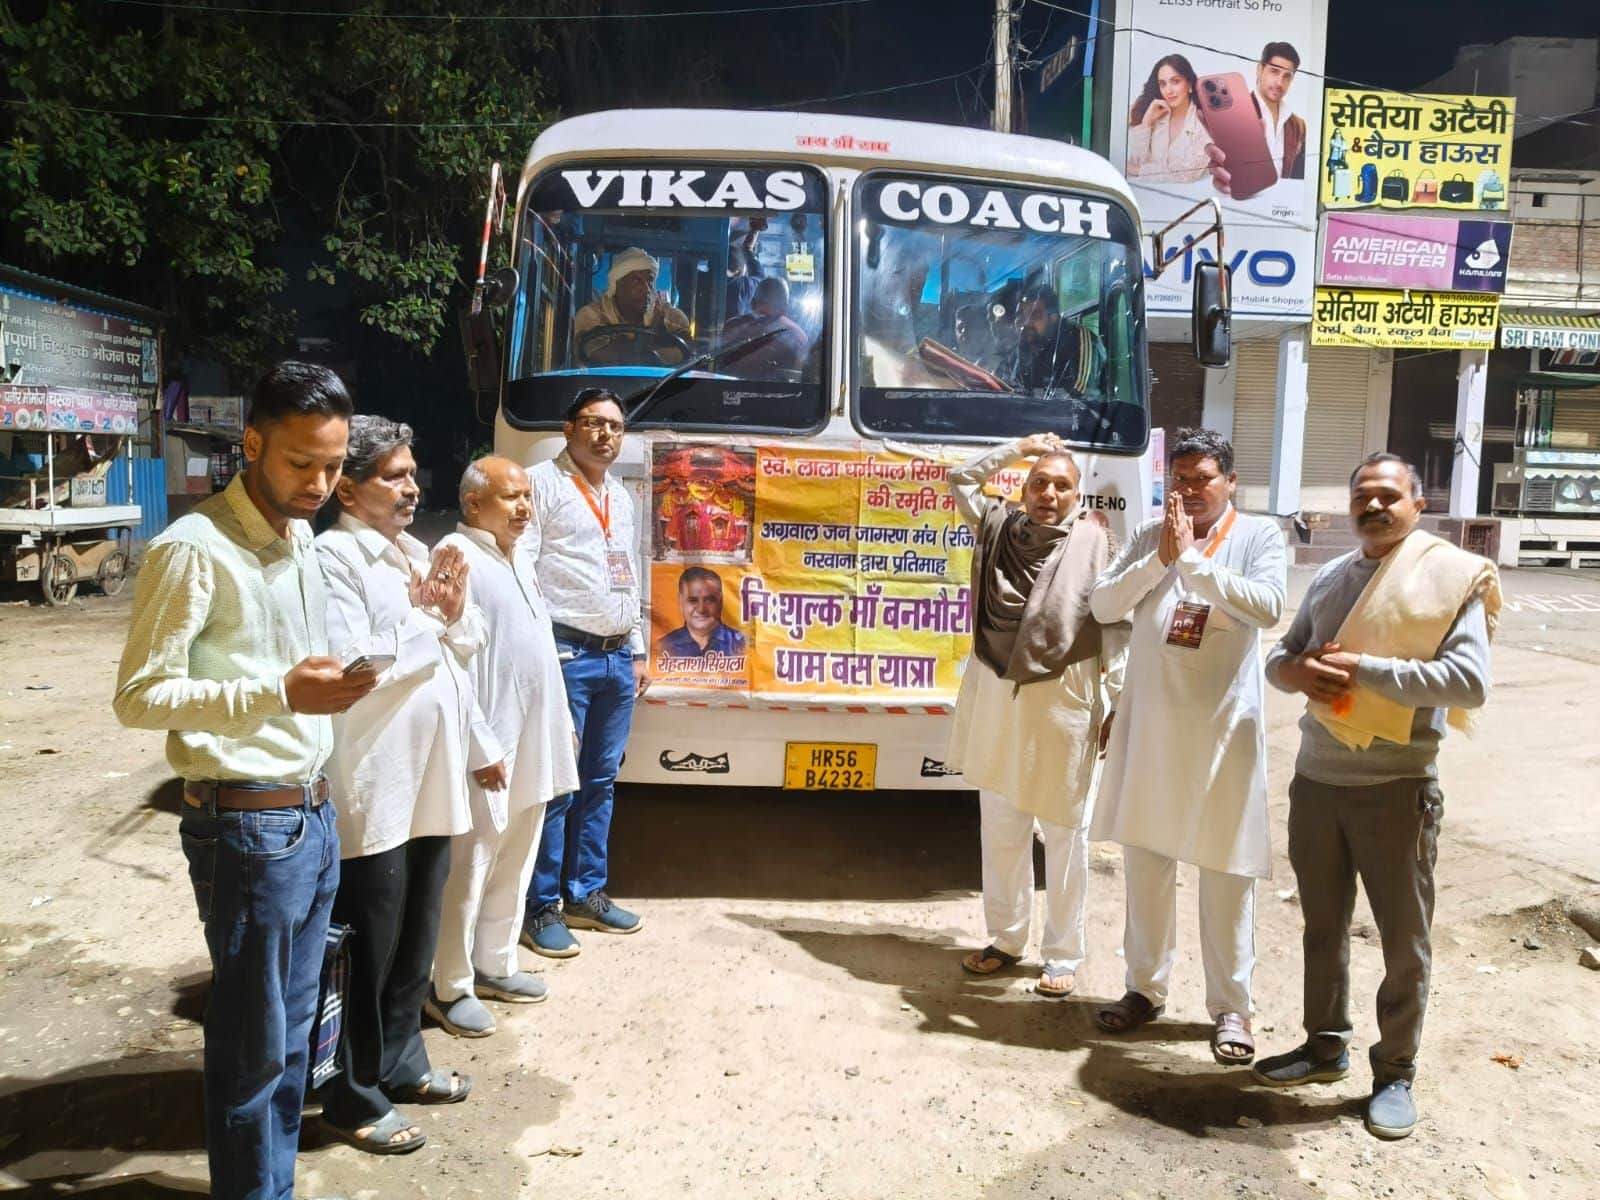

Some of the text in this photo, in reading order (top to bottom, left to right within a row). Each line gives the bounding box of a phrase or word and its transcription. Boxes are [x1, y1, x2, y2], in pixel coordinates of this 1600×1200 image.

[1244, 0, 1259, 10] So
[1262, 0, 1282, 12] Pro
[1330, 94, 1423, 131] सेतिया
[1419, 141, 1501, 165] हाऊस
[562, 169, 1111, 239] VIKAS COACH
[1332, 236, 1448, 255] AMERICAN
[1331, 250, 1447, 268] TOURISTER
[1316, 290, 1379, 323] सेतिया
[1440, 303, 1497, 327] हाऊस
[1505, 329, 1600, 348] SRI RAM CON
[797, 459, 841, 478] लाला
[910, 457, 951, 482] सिंग
[867, 485, 890, 508] की
[895, 487, 937, 516] स्मृति
[761, 522, 820, 543] अग्रवाल
[823, 524, 850, 542] जन
[855, 525, 908, 545] जागरण
[912, 523, 938, 546] मंच
[804, 550, 947, 576] नरवाना द्वारा प्रतिमाह
[776, 649, 936, 689] धाम बस यात्रा
[811, 749, 857, 768] HR56
[806, 769, 863, 788] B4232
